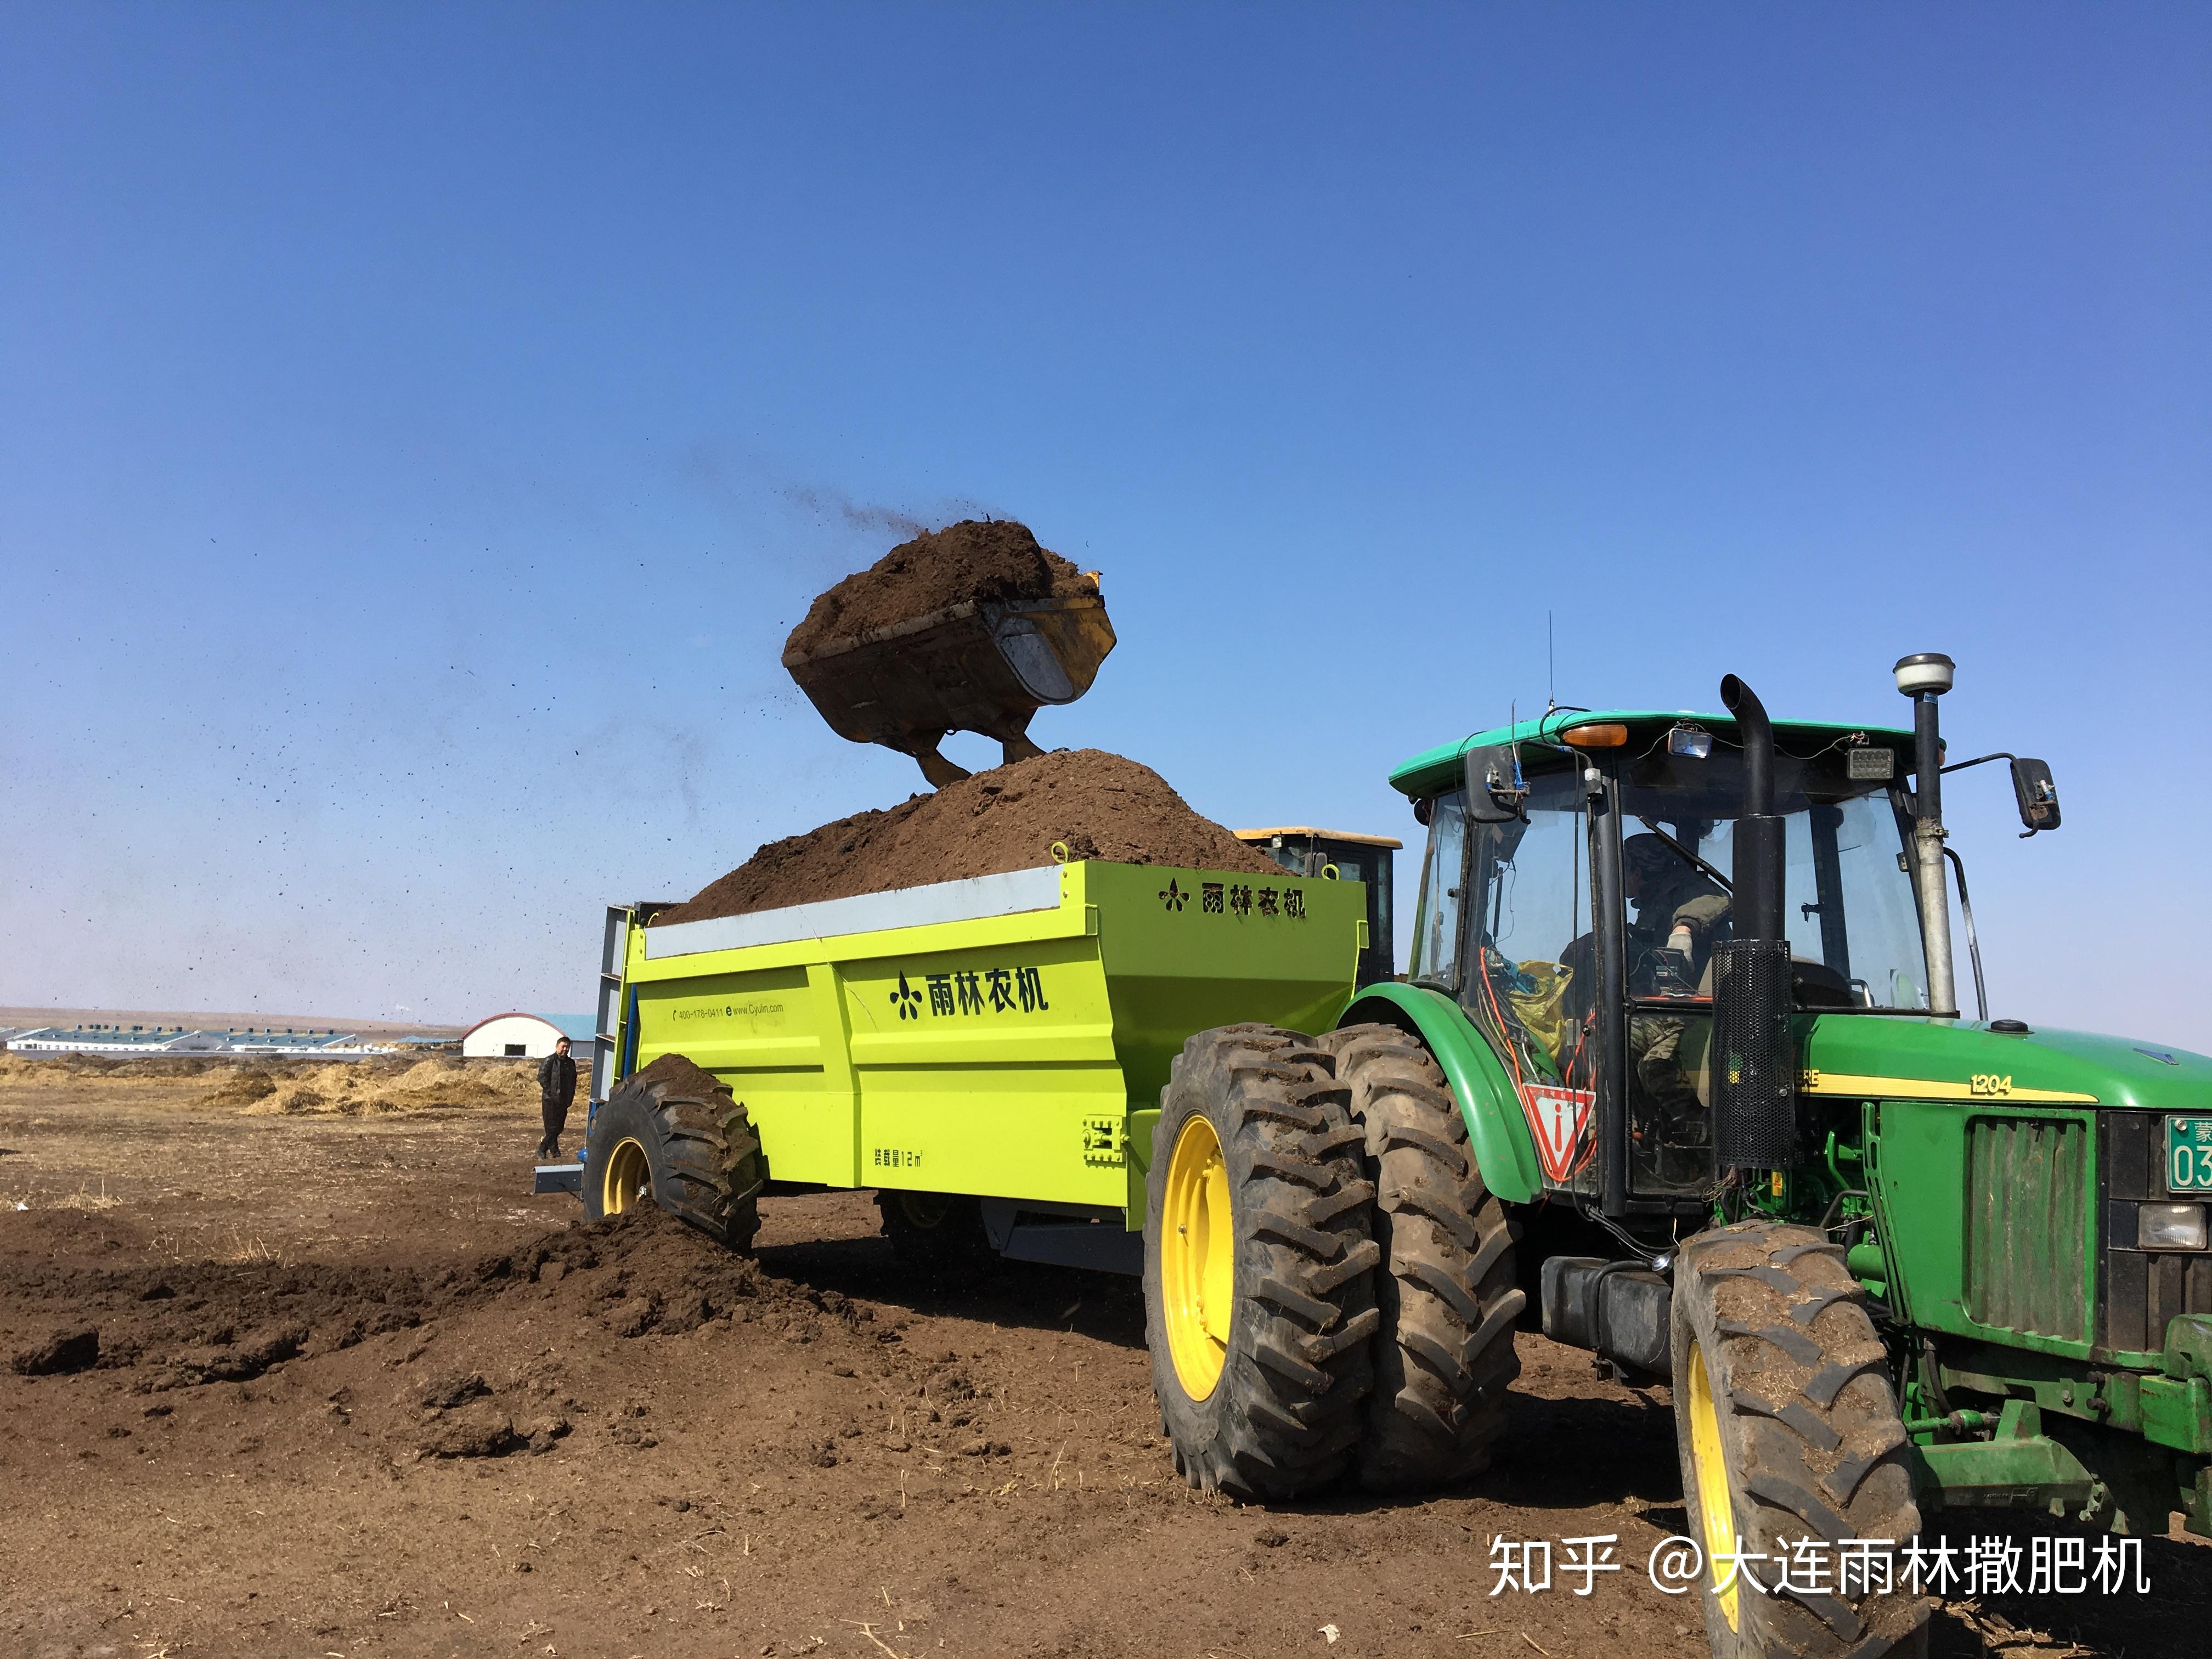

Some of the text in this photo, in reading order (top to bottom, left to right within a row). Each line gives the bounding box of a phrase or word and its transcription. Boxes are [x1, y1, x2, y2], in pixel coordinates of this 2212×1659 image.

[1202, 882, 1307, 919] 雨林农机
[926, 967, 1049, 1017] 雨林农机
[679, 1008, 723, 1020] 400-178-0411
[1971, 1075, 2012, 1093] 1204
[2174, 1145, 2212, 1187] 03
